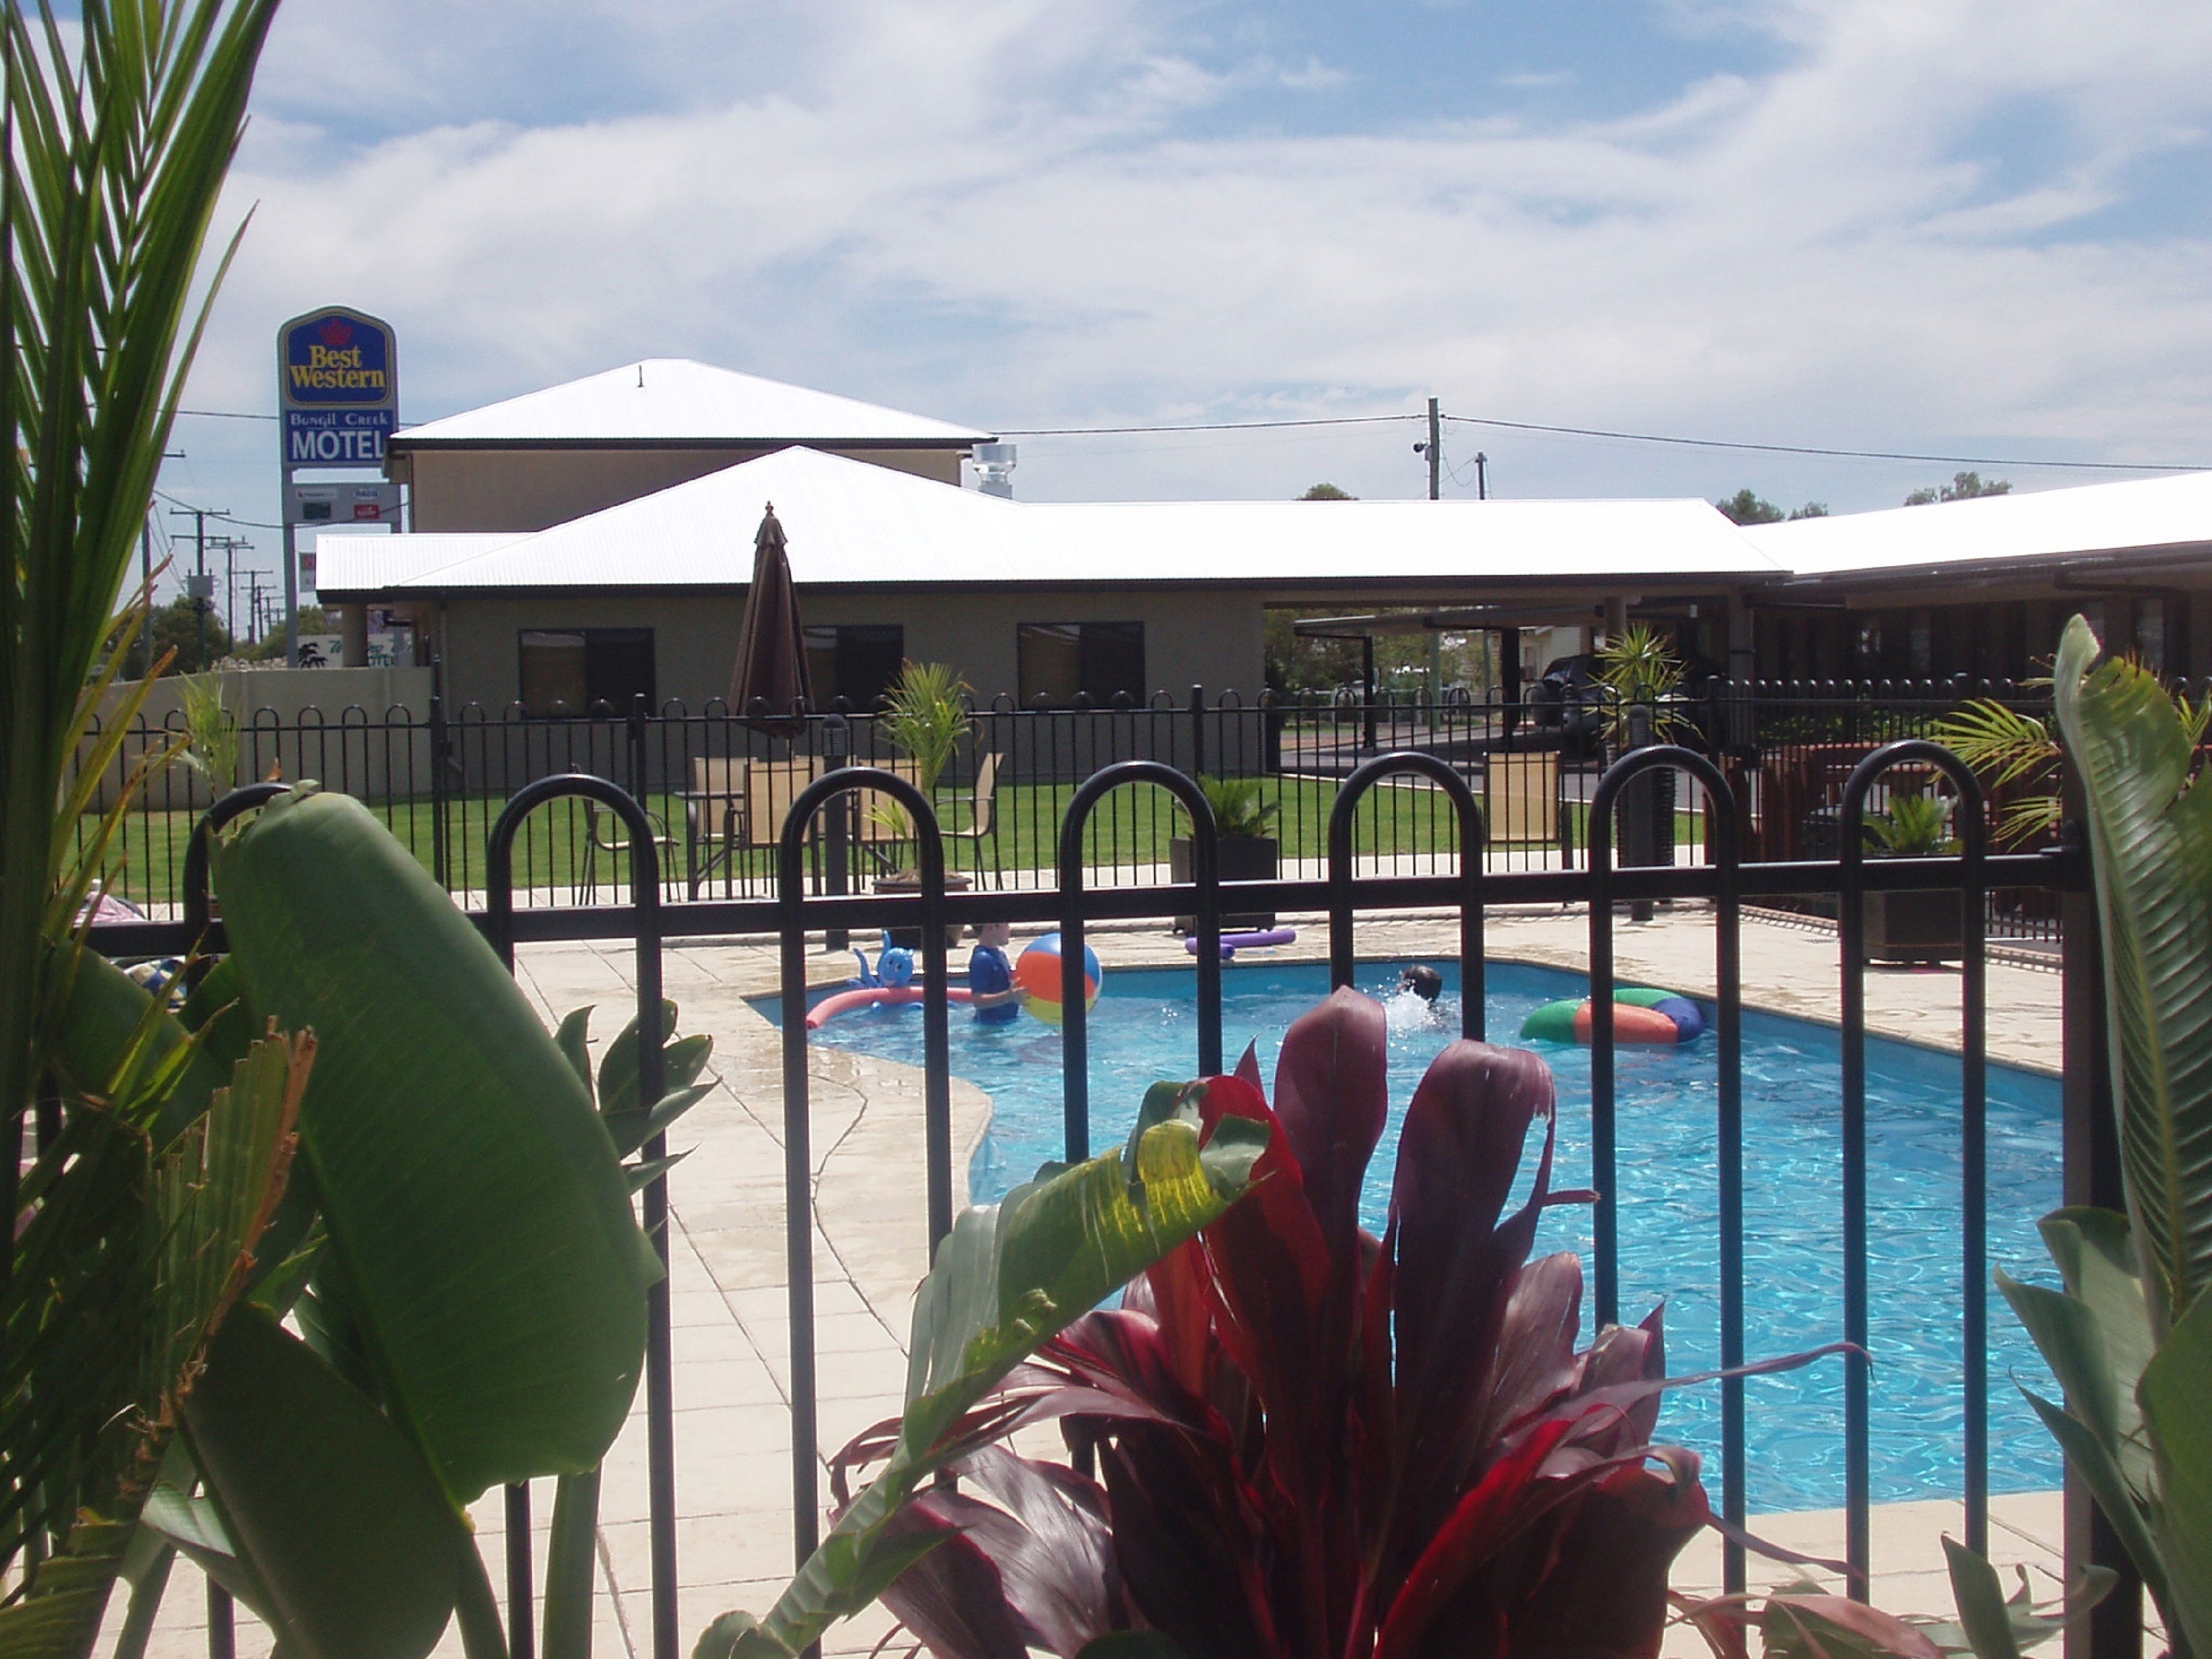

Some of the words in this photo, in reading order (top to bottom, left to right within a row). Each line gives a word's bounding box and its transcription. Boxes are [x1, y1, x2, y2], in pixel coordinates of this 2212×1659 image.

[309, 346, 362, 368] Best
[290, 365, 385, 388] Western
[292, 431, 384, 459] MOTEL
